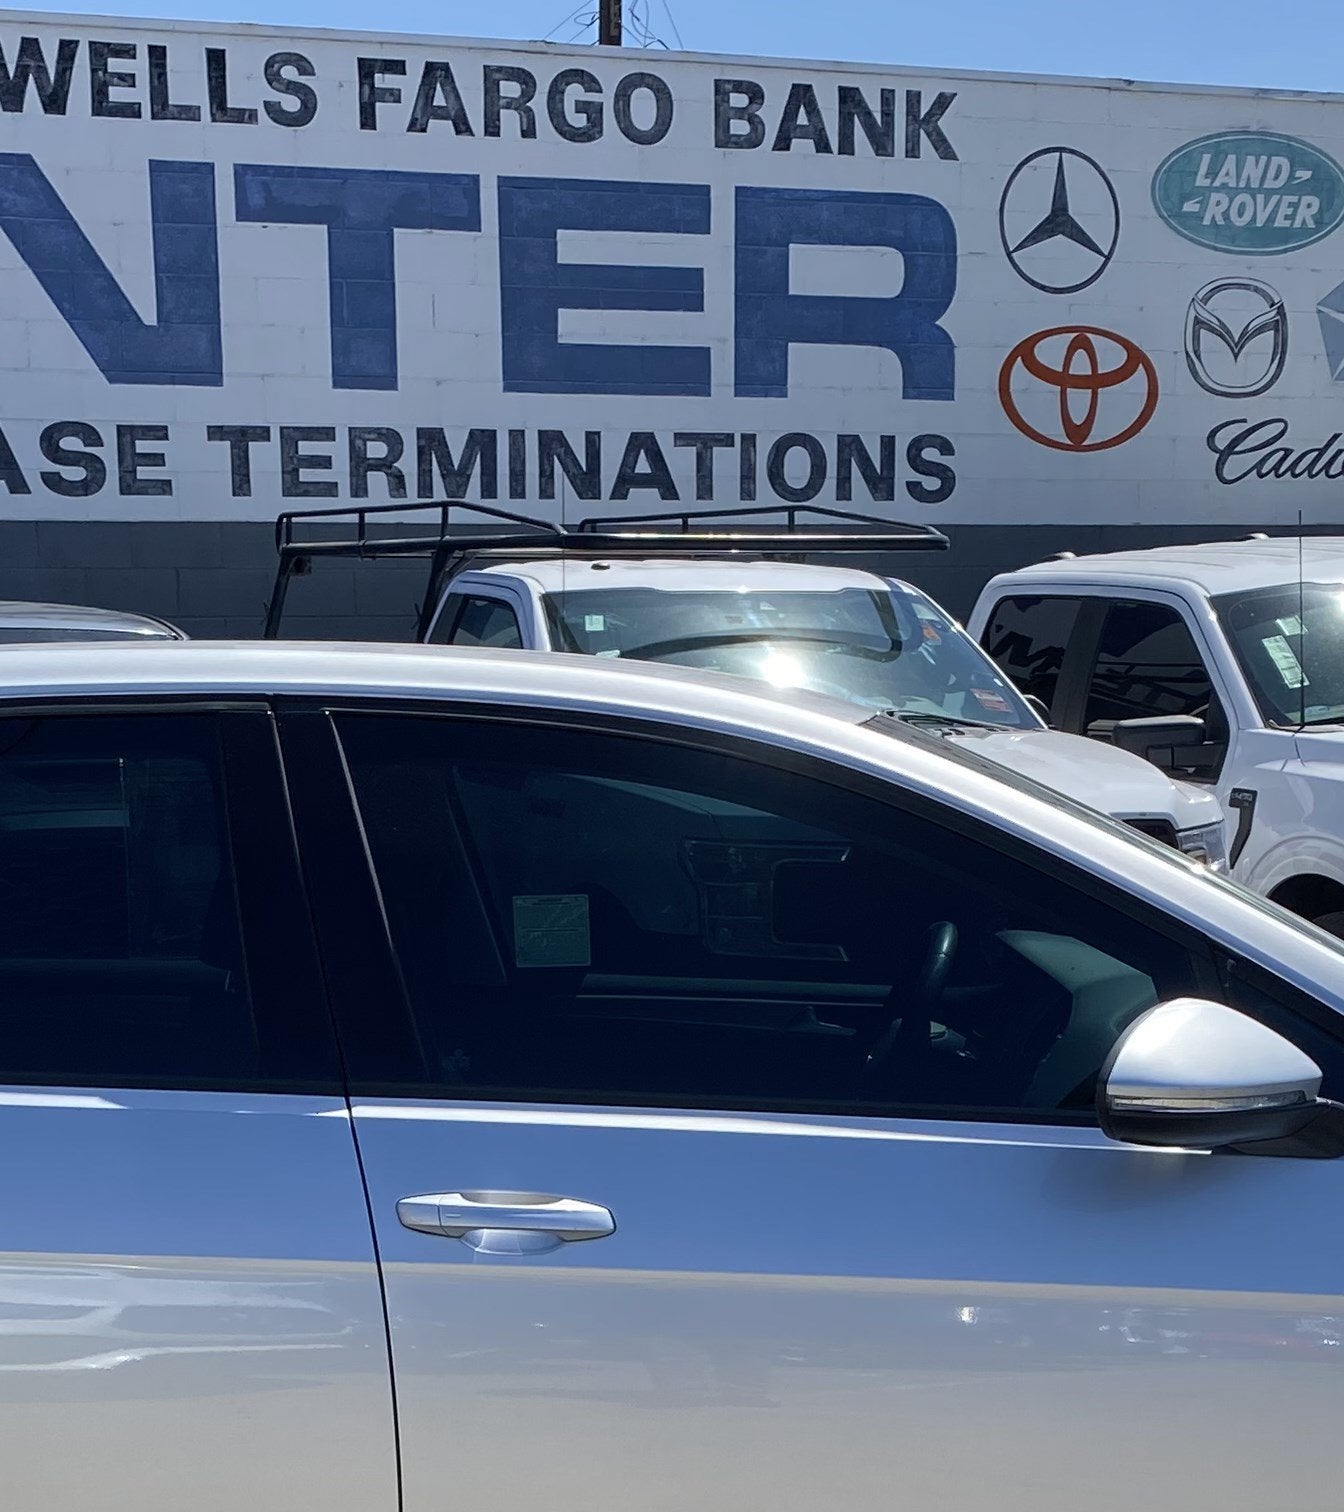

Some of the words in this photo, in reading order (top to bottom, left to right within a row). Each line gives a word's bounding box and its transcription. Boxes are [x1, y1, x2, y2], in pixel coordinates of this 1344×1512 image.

[357, 56, 674, 146] FARGO
[714, 78, 959, 162] BANK
[206, 424, 958, 505] TERMINATIONS
